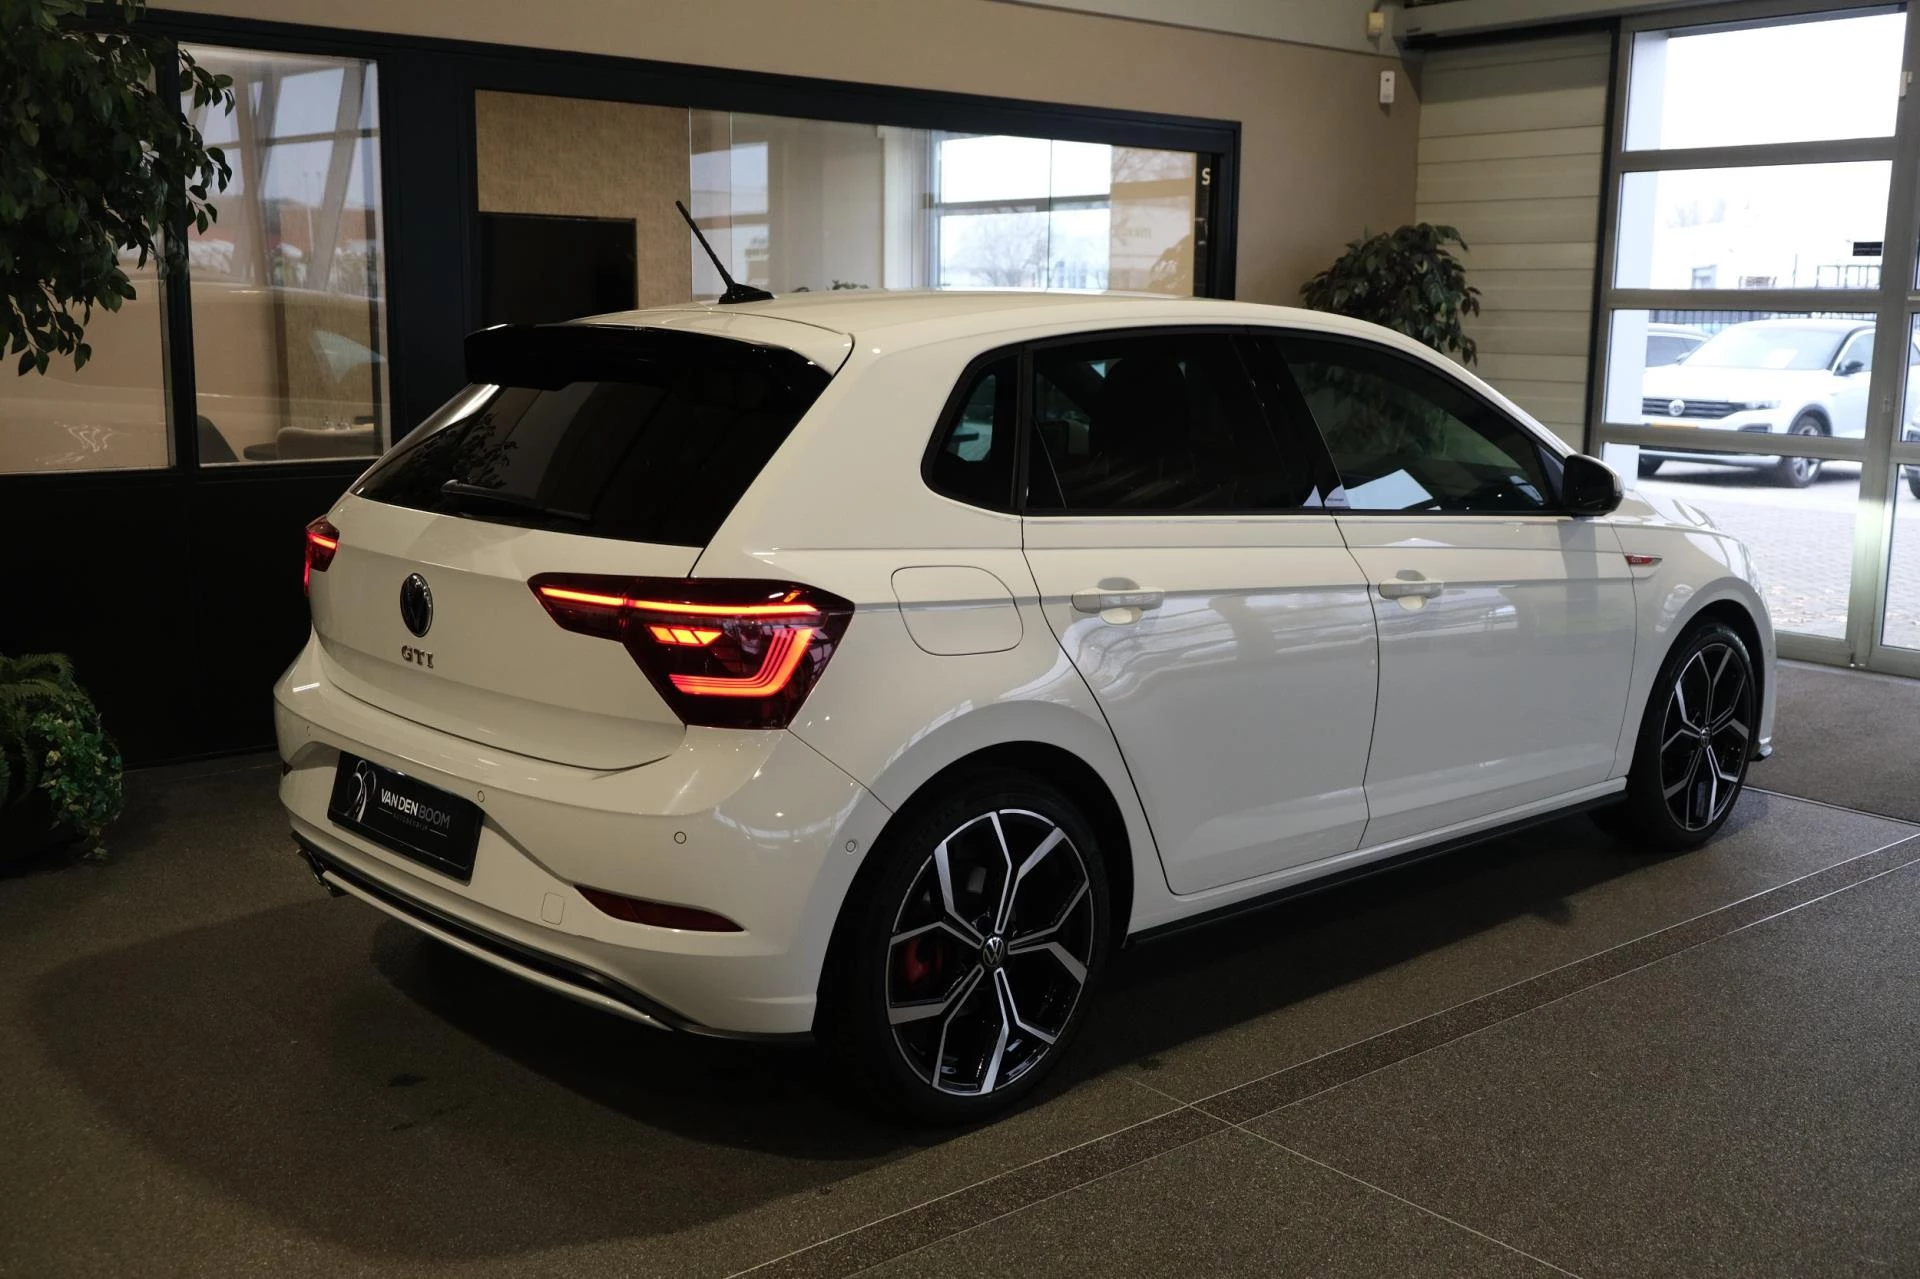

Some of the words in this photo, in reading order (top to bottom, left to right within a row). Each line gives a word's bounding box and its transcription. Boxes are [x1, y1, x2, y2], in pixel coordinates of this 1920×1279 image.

[401, 645, 434, 669] GTI
[381, 788, 399, 808] VAN
[398, 795, 419, 817] DEN
[418, 805, 451, 829] BOOM
